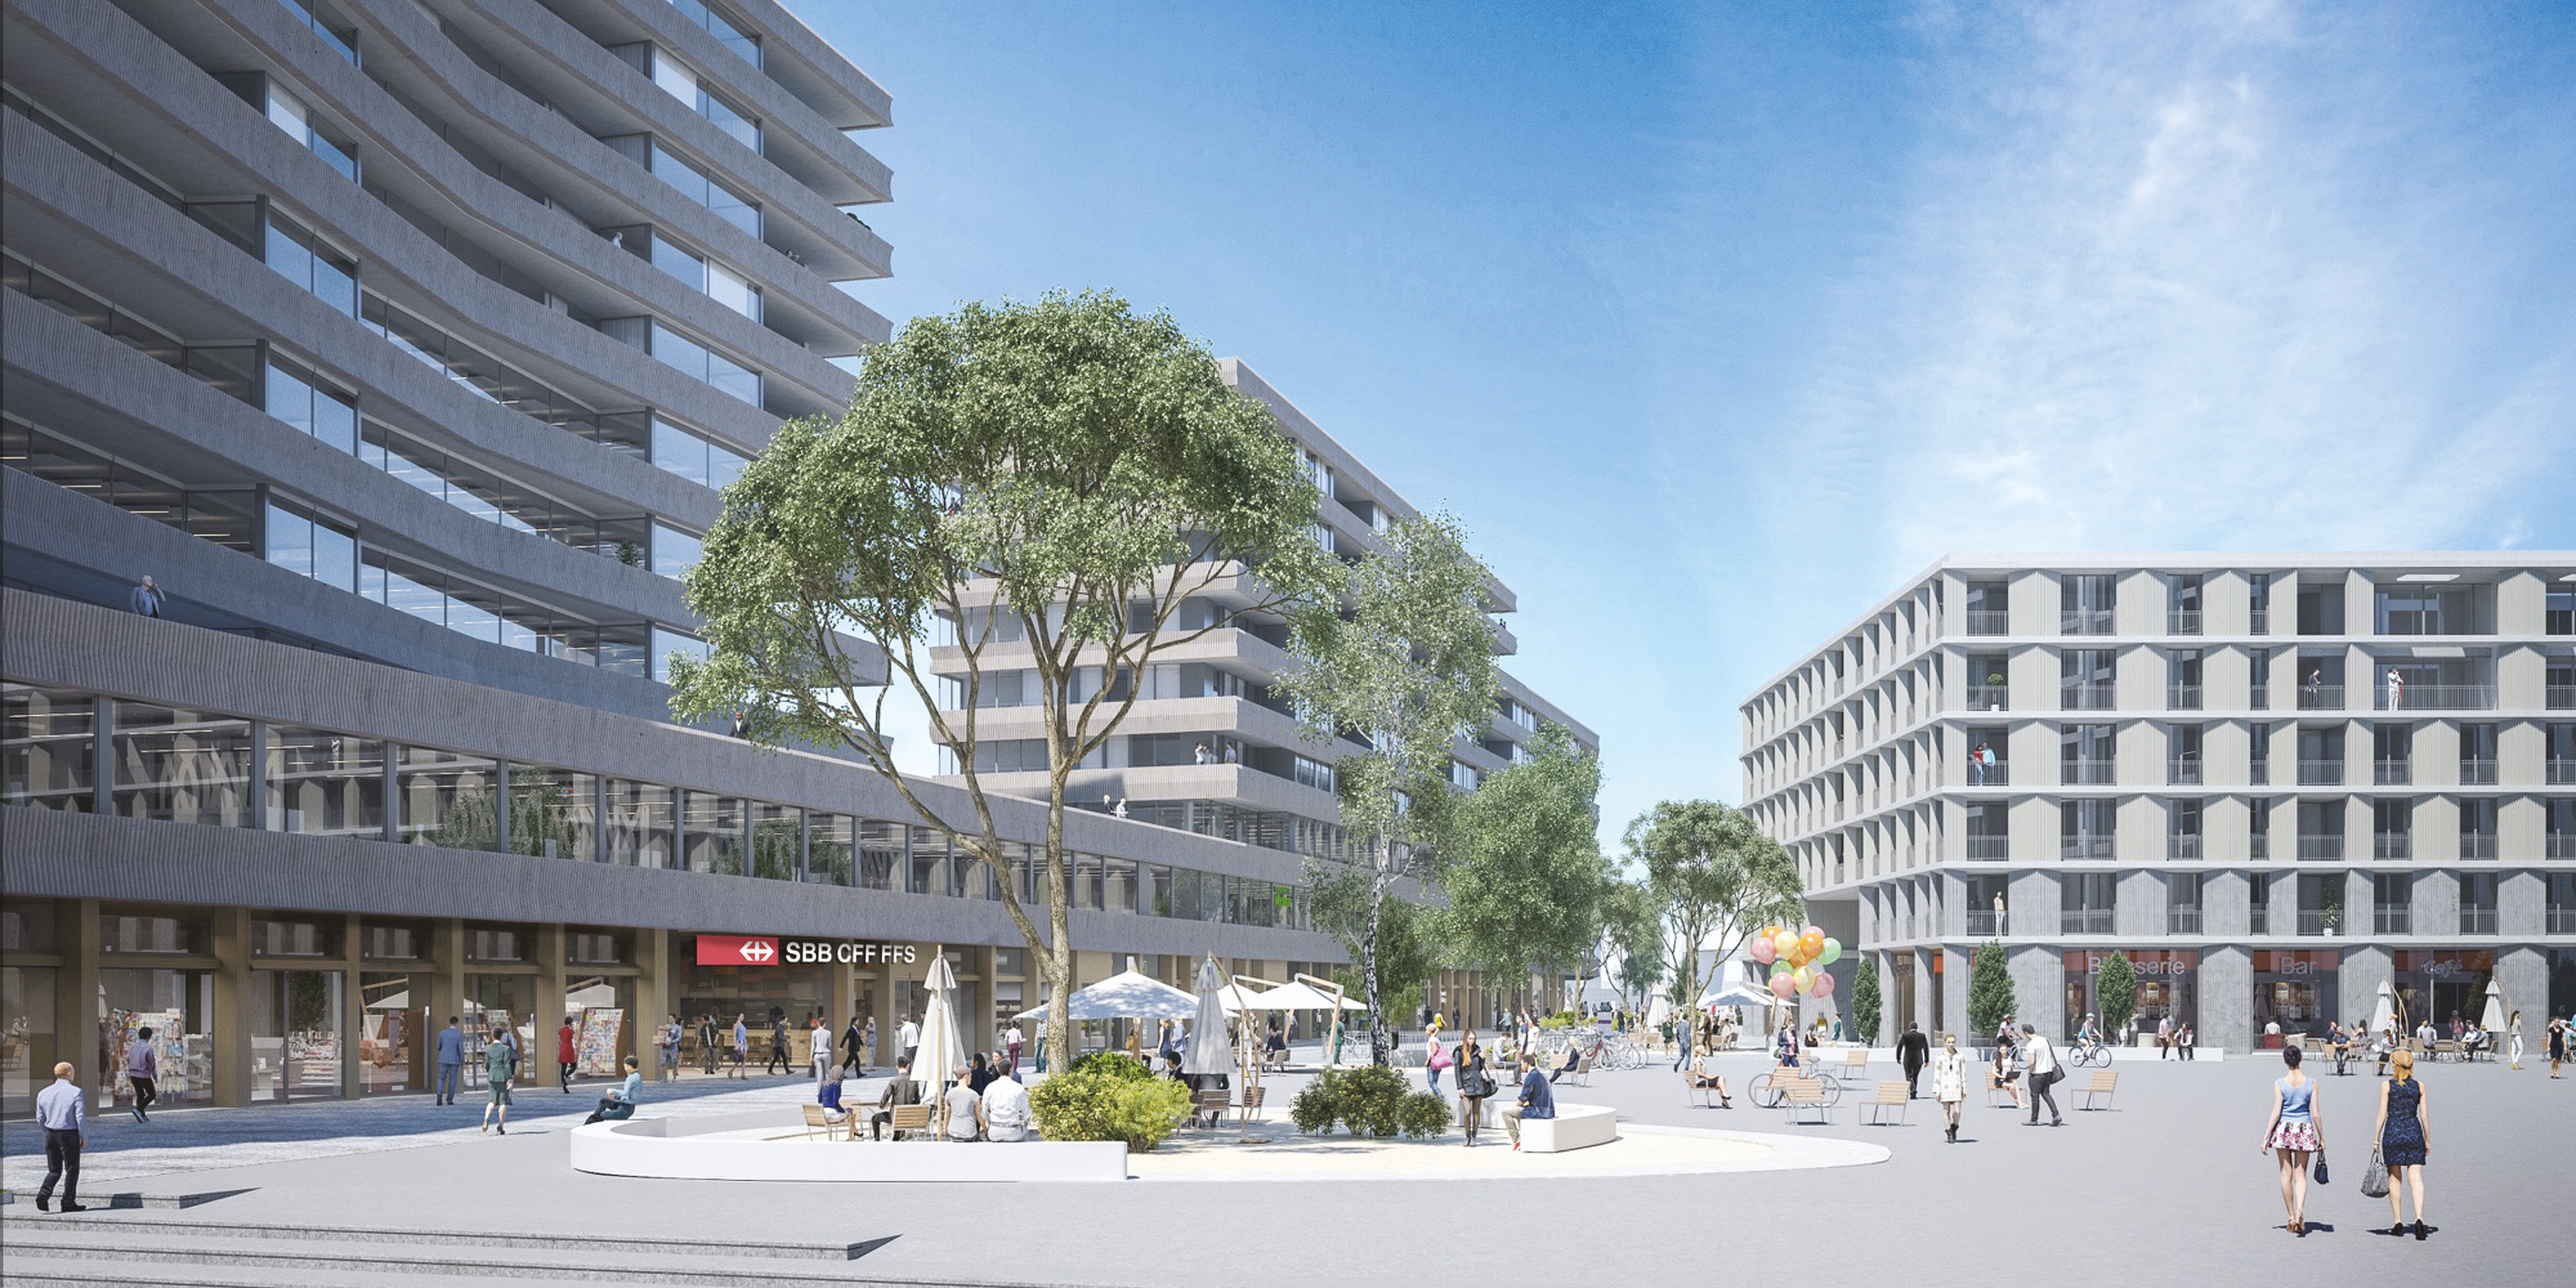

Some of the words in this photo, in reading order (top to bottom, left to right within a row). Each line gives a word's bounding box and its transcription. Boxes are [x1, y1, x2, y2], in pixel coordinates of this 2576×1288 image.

[785, 942, 833, 963] SBB
[837, 944, 877, 963] CFF
[881, 944, 916, 963] FFS
[2087, 956, 2185, 975] Bserie
[2281, 956, 2316, 974] Bar
